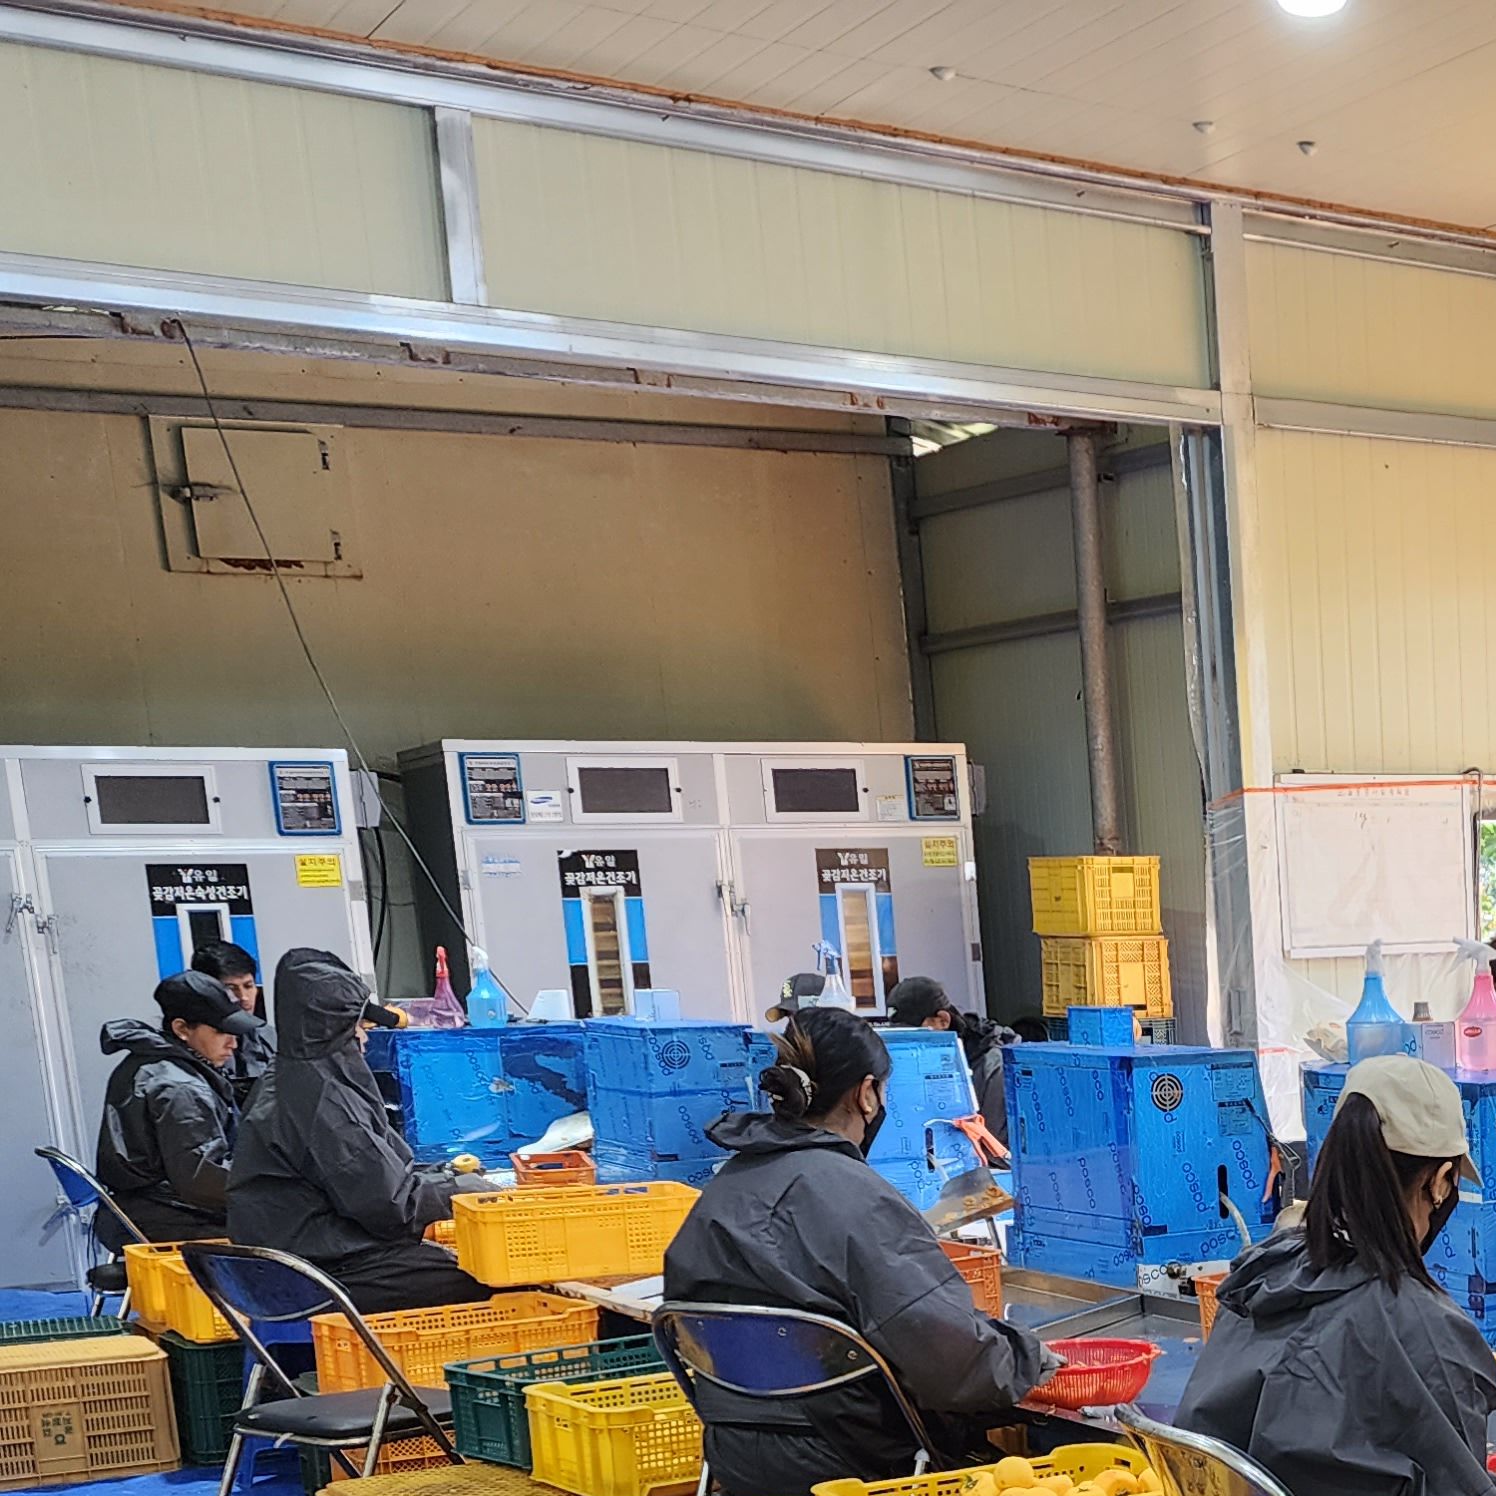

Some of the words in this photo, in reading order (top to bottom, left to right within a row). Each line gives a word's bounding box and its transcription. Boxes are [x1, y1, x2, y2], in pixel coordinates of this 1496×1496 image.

[152, 885, 248, 901] 곶감저온숙성건조기
[564, 870, 638, 886] 곶감저온건조기
[700, 1036, 715, 1061] pos
[1032, 1083, 1045, 1132] osco
[1232, 1140, 1259, 1190] posco
[1134, 1184, 1152, 1226] osco
[1182, 1162, 1212, 1213] posco
[1200, 1228, 1241, 1258] posc
